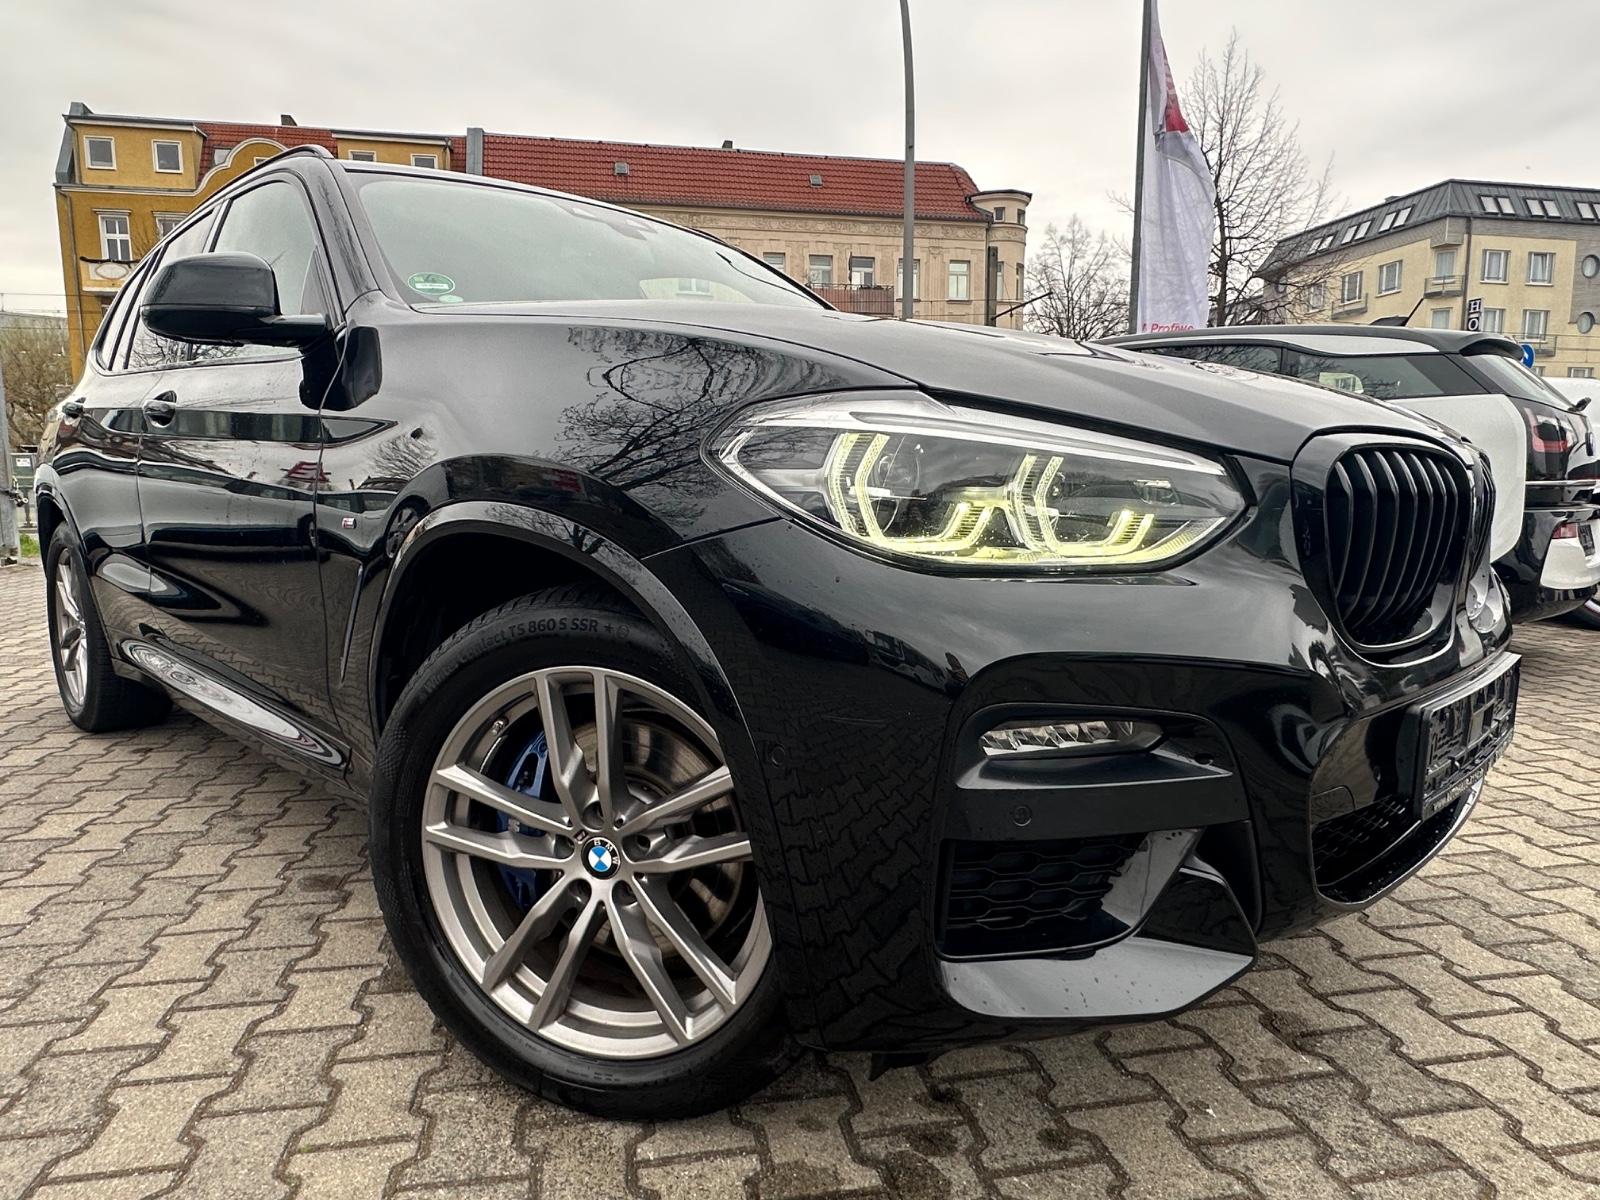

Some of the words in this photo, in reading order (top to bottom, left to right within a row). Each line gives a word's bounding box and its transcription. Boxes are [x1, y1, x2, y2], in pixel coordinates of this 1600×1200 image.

[508, 623, 526, 638] TS
[528, 618, 556, 634] 860
[559, 617, 567, 631] S
[570, 617, 598, 633] SSR
[593, 839, 619, 865] BMW
